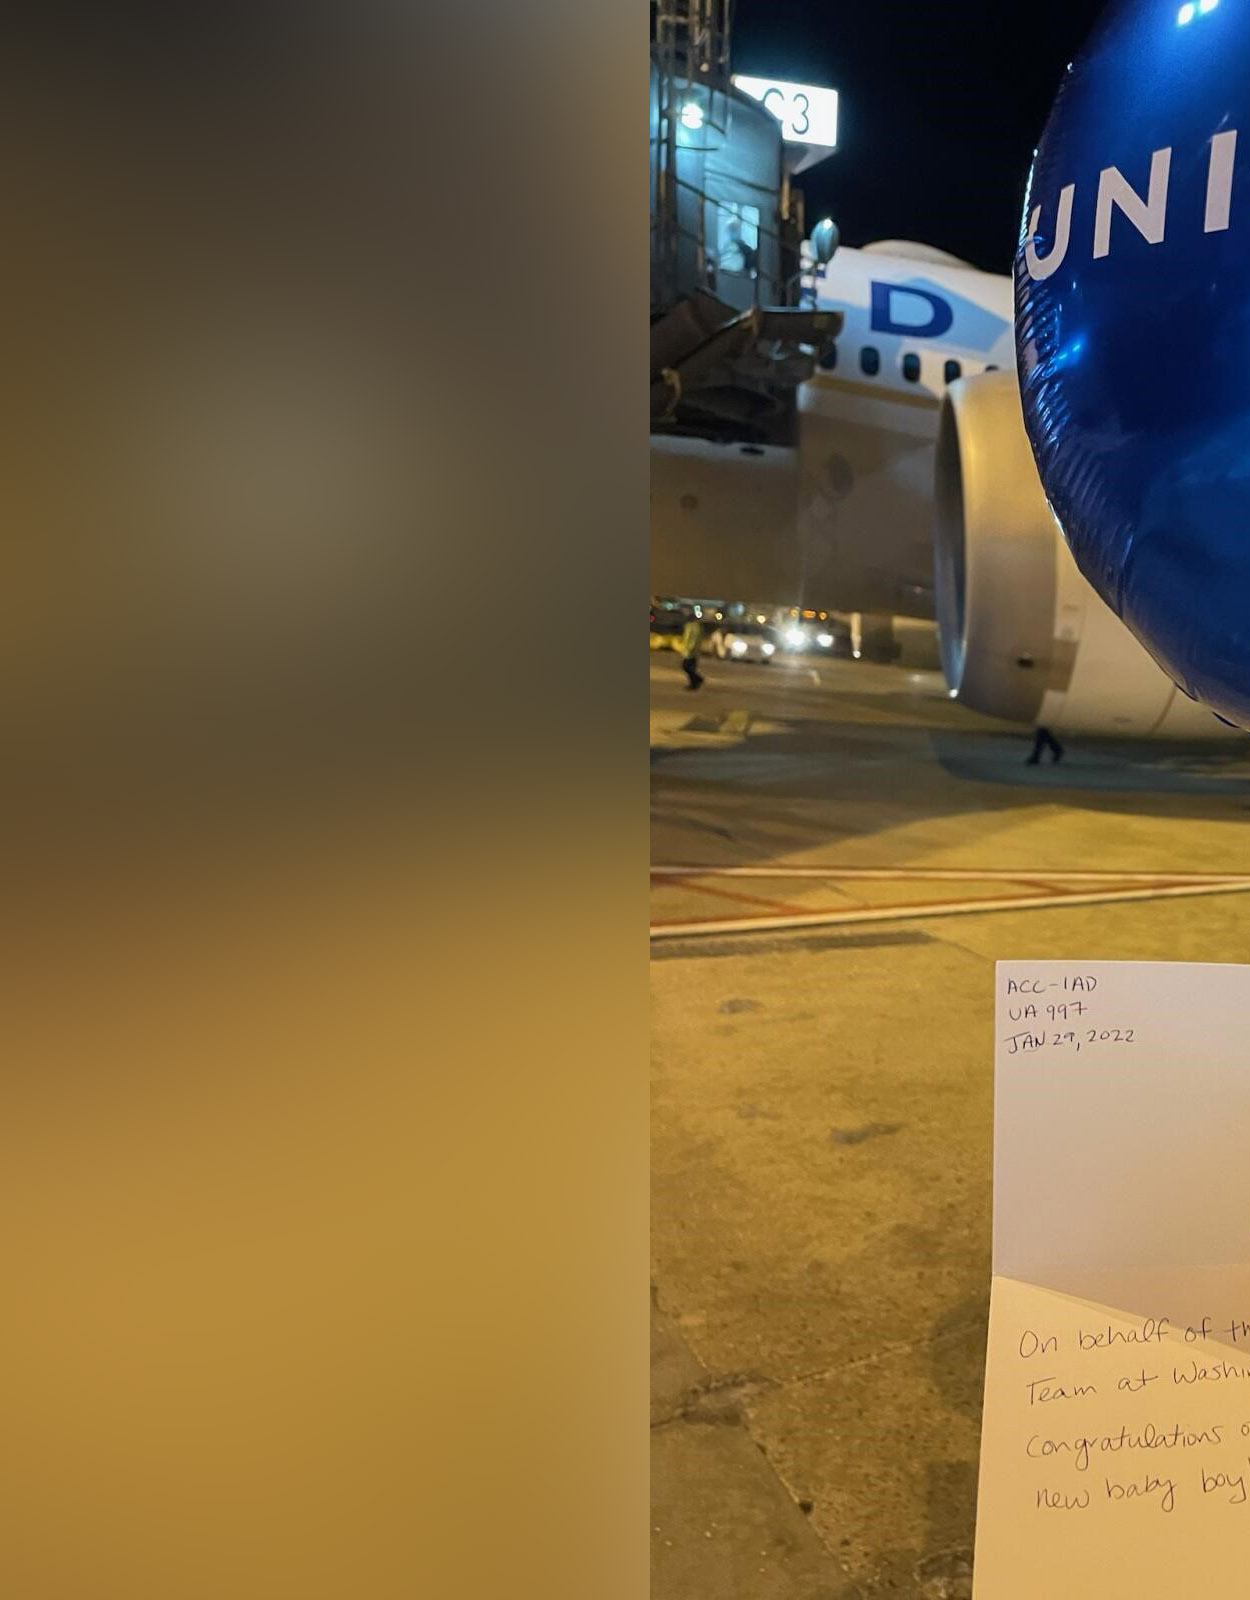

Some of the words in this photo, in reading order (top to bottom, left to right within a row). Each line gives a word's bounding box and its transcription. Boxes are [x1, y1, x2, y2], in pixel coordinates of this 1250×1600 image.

[1009, 1004, 1036, 1021] UA
[1046, 1001, 1088, 1021] 997
[1003, 1031, 1046, 1054] JAN
[1086, 1029, 1135, 1043] 2022
[1019, 1330, 1058, 1359] On
[1079, 1317, 1170, 1351] behalf
[1184, 1317, 1212, 1343] of
[1026, 1377, 1097, 1406] Team
[1117, 1369, 1159, 1392] at
[1036, 1488, 1091, 1510] new
[1105, 1474, 1177, 1513] baby
